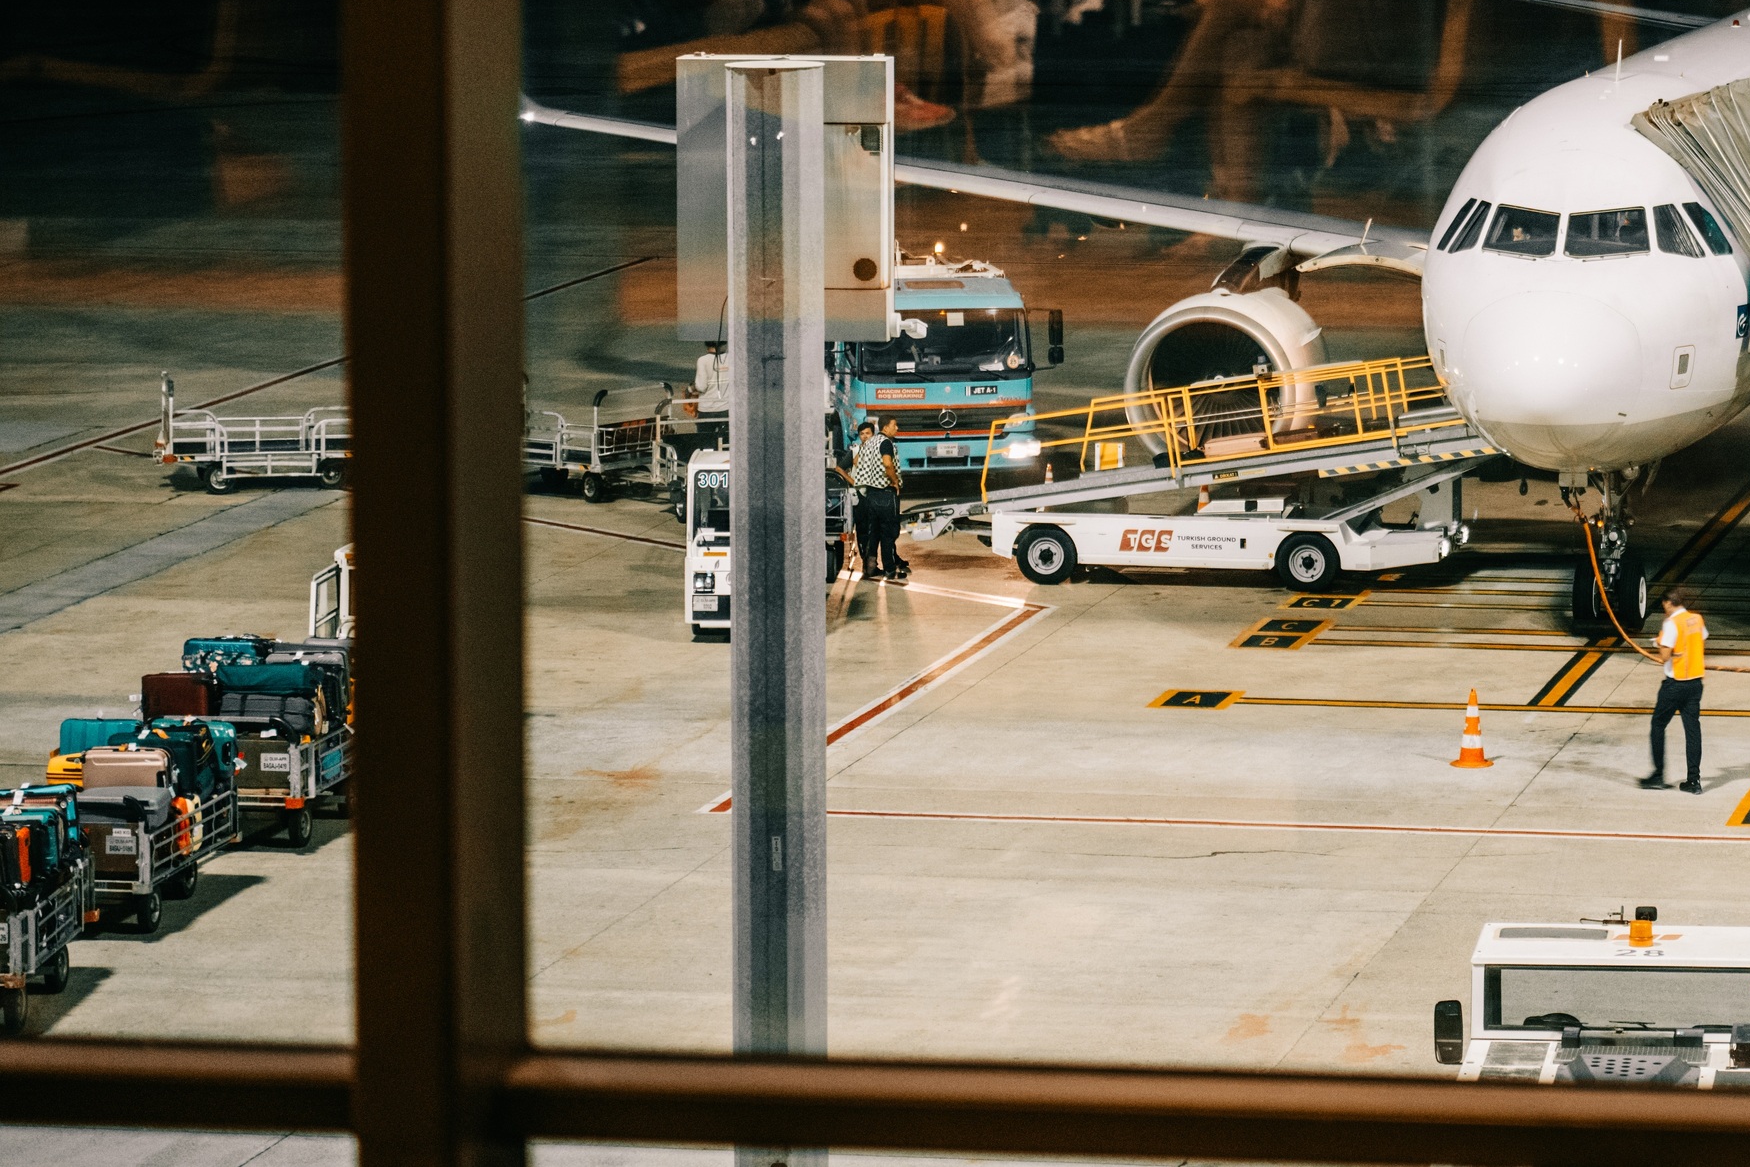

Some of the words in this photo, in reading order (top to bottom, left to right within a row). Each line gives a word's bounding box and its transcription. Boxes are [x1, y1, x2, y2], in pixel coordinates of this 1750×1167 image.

[698, 472, 729, 488] 301
[1123, 531, 1173, 551] TGS
[1191, 543, 1223, 551] SERVICES
[1281, 622, 1294, 631] C
[1259, 637, 1280, 646] B
[1182, 695, 1202, 705] A
[1615, 949, 1665, 957] 28
